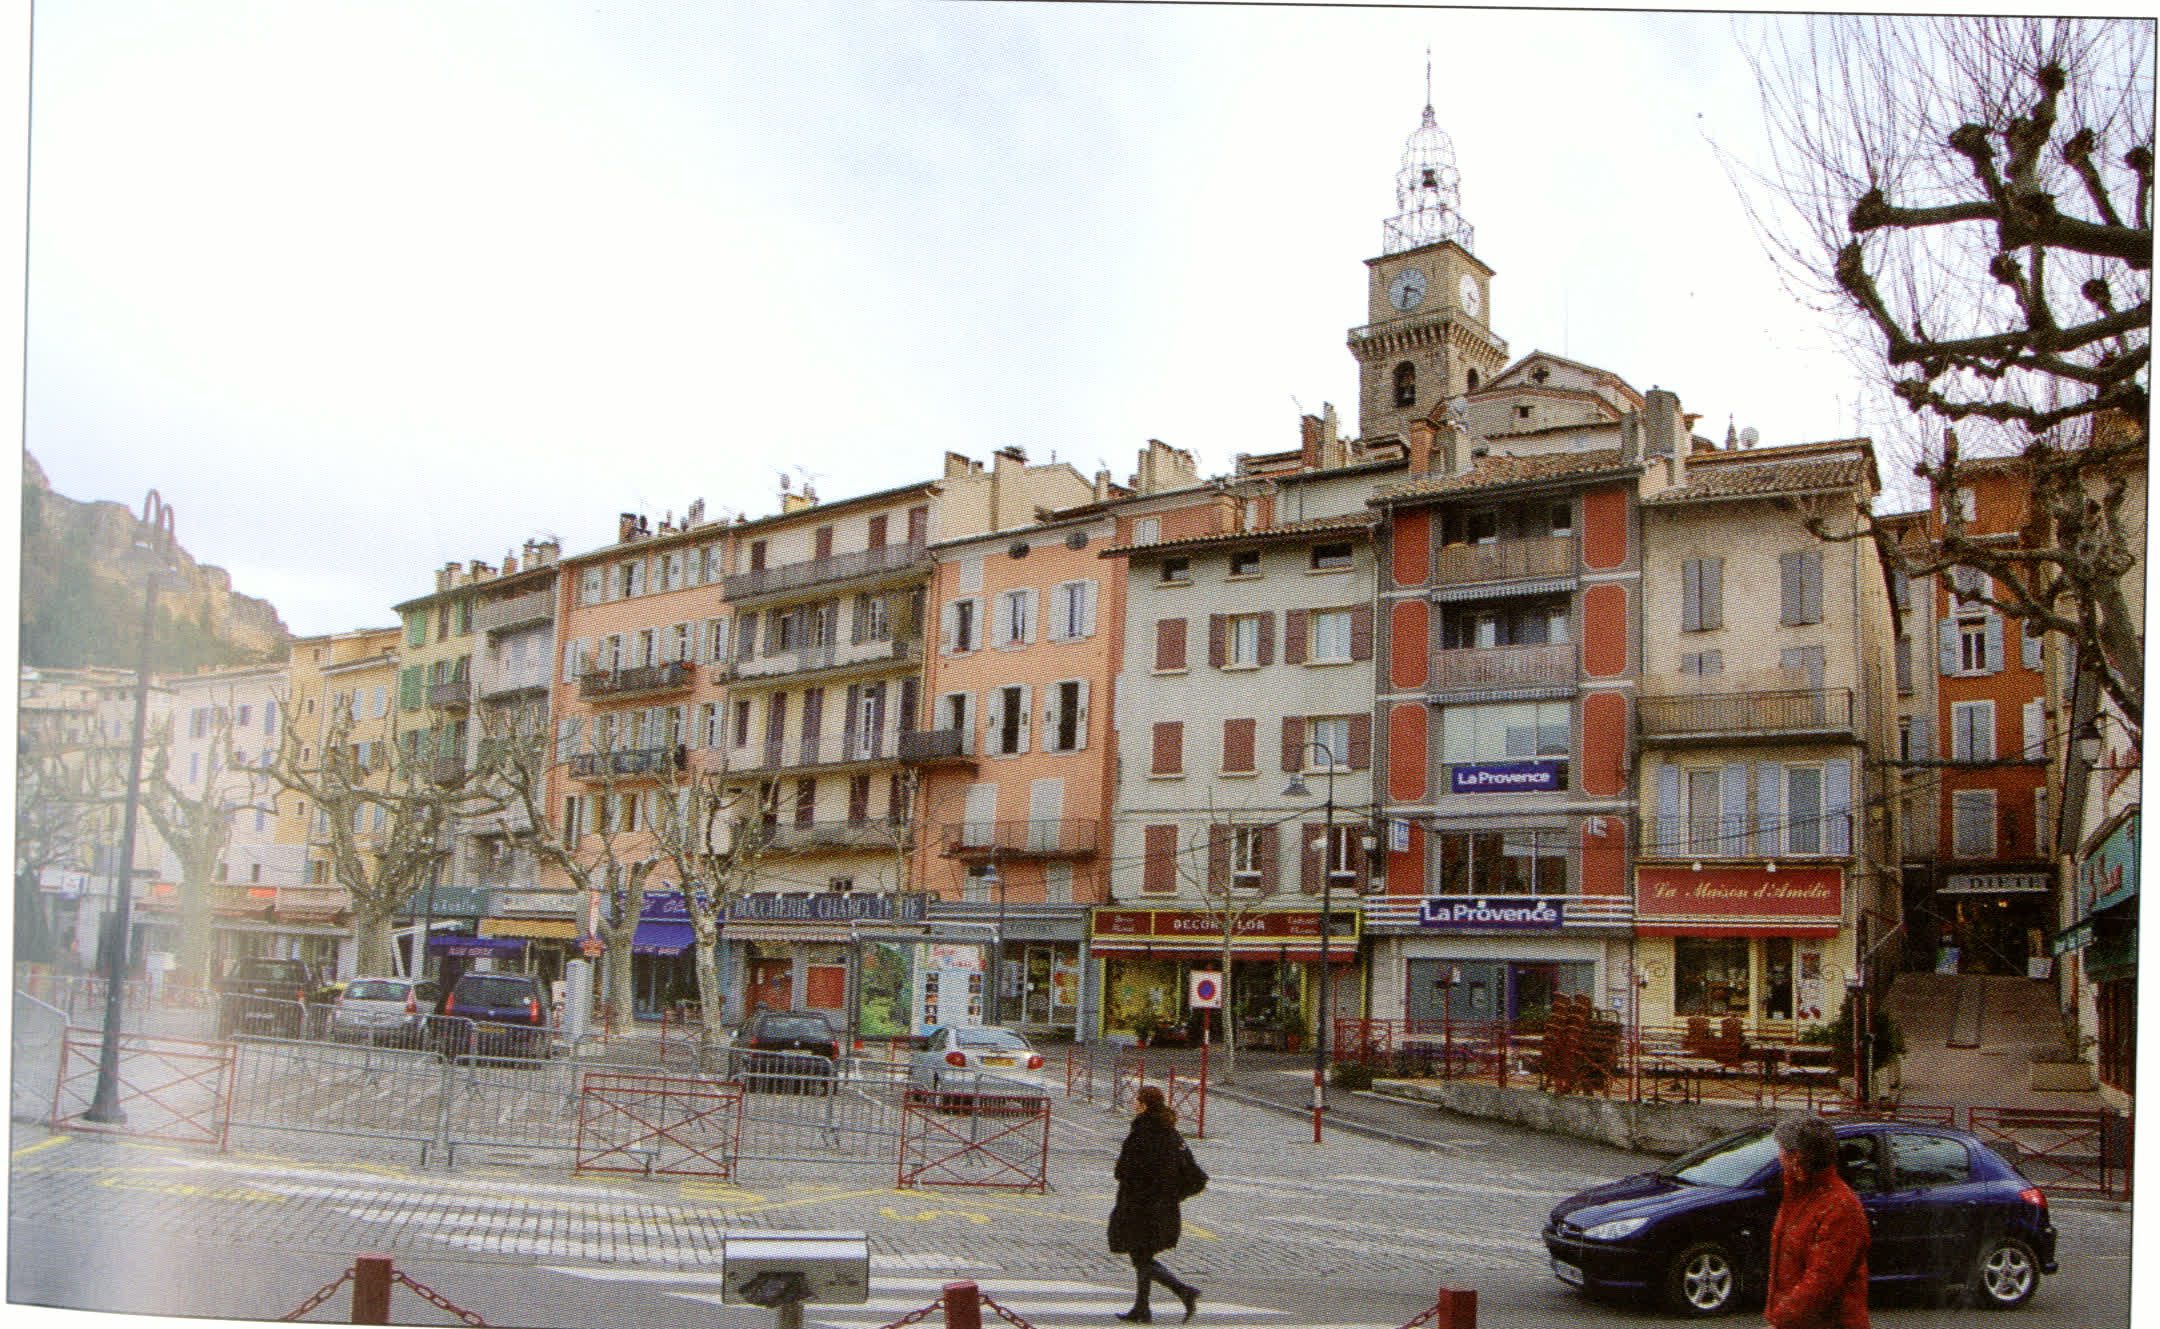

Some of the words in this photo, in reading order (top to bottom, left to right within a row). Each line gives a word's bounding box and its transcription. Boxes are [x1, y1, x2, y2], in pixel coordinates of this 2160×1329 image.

[1457, 772, 1477, 785] La
[1478, 771, 1551, 785] Provence
[1654, 882, 1676, 899] La
[1685, 881, 1750, 900] Maison
[817, 897, 920, 919] CHARCUTEIE
[1424, 902, 1450, 921] La
[1453, 904, 1558, 922] Provence
